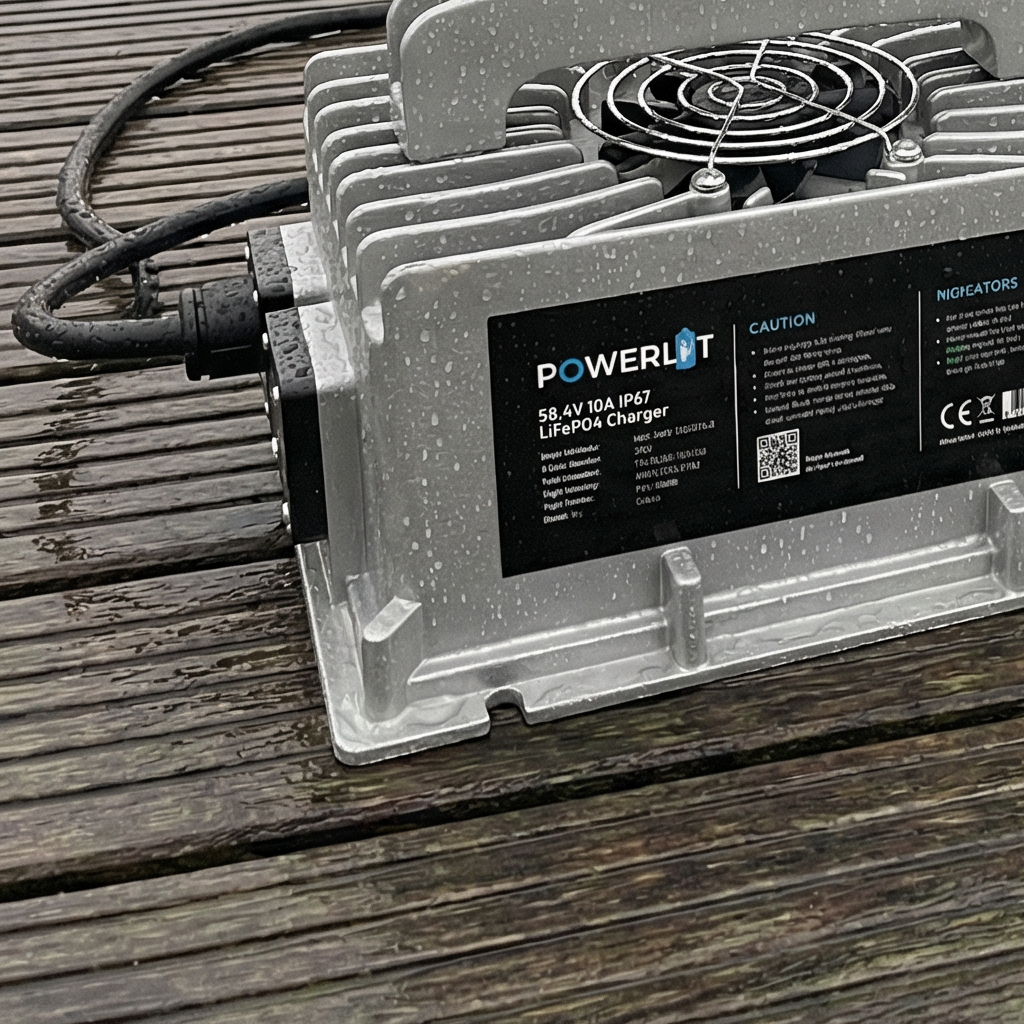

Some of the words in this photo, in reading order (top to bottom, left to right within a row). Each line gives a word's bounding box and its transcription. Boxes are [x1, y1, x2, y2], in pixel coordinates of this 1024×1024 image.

[748, 312, 816, 335] CAUTION
[537, 327, 714, 389] POWERLT
[587, 397, 615, 414] 10A
[619, 389, 651, 408] IP67
[606, 406, 670, 427] Charger
[940, 399, 972, 430] CE
